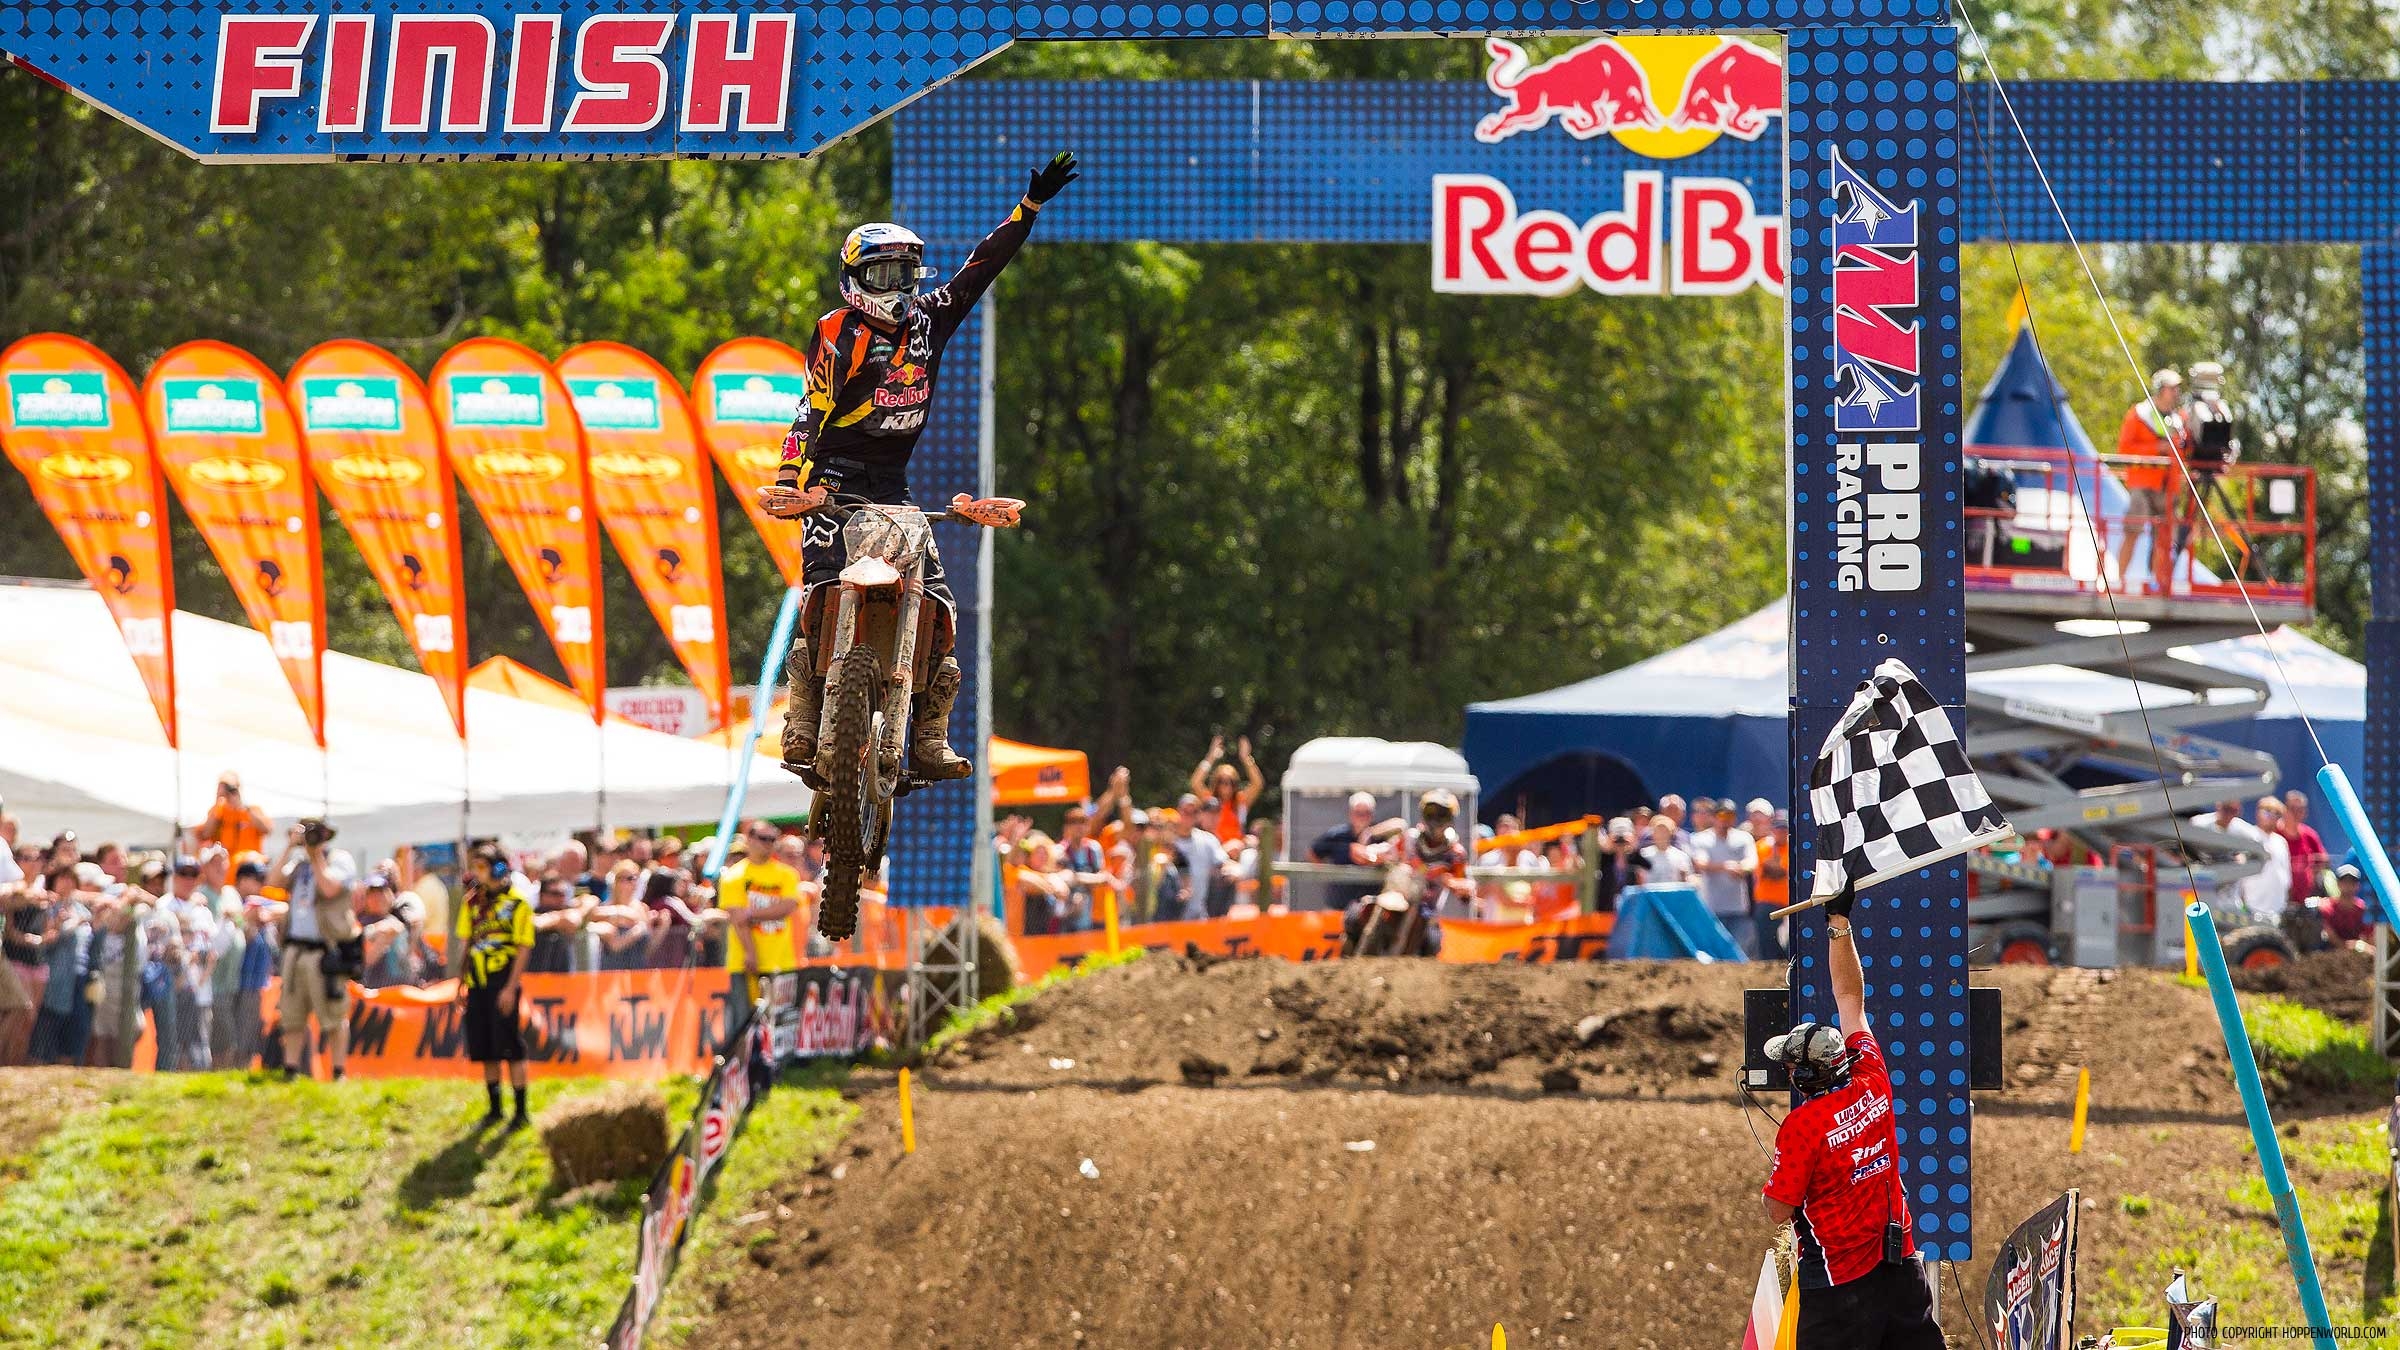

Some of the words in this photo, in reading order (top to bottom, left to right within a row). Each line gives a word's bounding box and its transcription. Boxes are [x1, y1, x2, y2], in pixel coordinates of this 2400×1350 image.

[209, 13, 797, 133] FINISH
[1433, 172, 1662, 296] Red
[1832, 144, 1920, 432] AMA
[854, 293, 877, 317] Bull
[874, 387, 908, 407] Red
[880, 409, 925, 430] KTM
[1837, 444, 1863, 592] RACING
[1867, 444, 1921, 592] PRO
[1838, 1102, 1861, 1124] LUCAS
